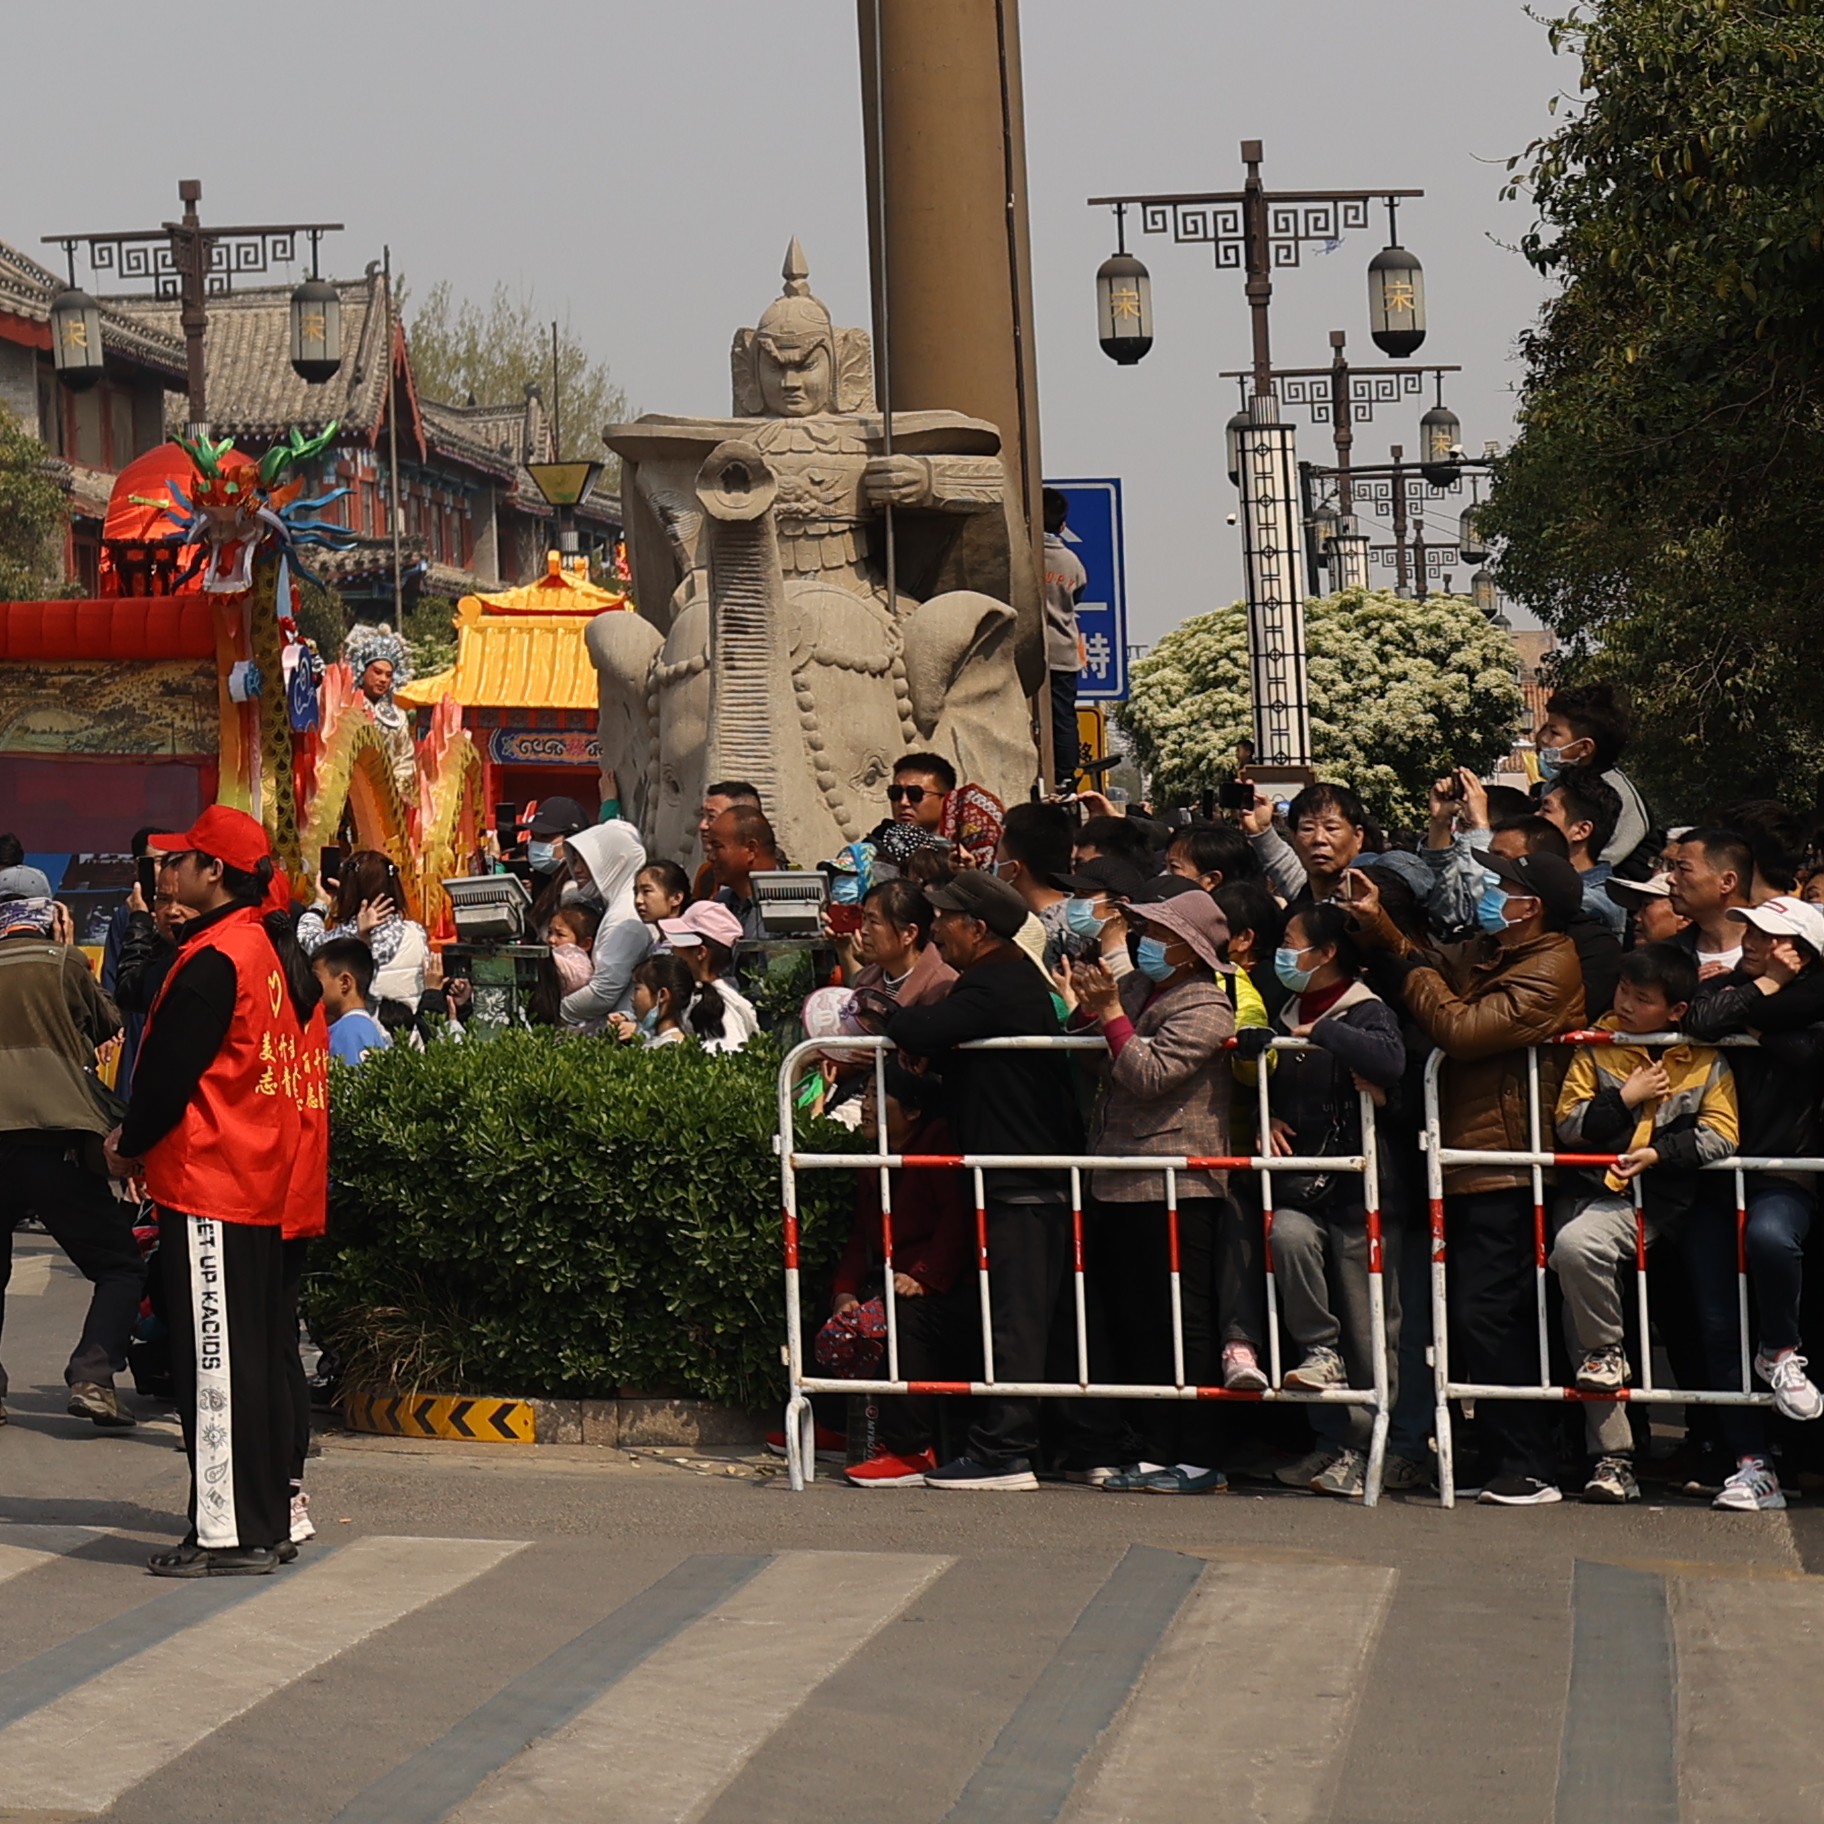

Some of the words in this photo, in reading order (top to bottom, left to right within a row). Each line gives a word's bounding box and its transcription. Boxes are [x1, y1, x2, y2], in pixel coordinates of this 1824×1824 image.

[1110, 287, 1141, 320] 宋
[1384, 280, 1416, 313] 宋
[61, 319, 88, 351] 宋
[301, 312, 326, 344] 宋
[199, 1255, 218, 1283] UP
